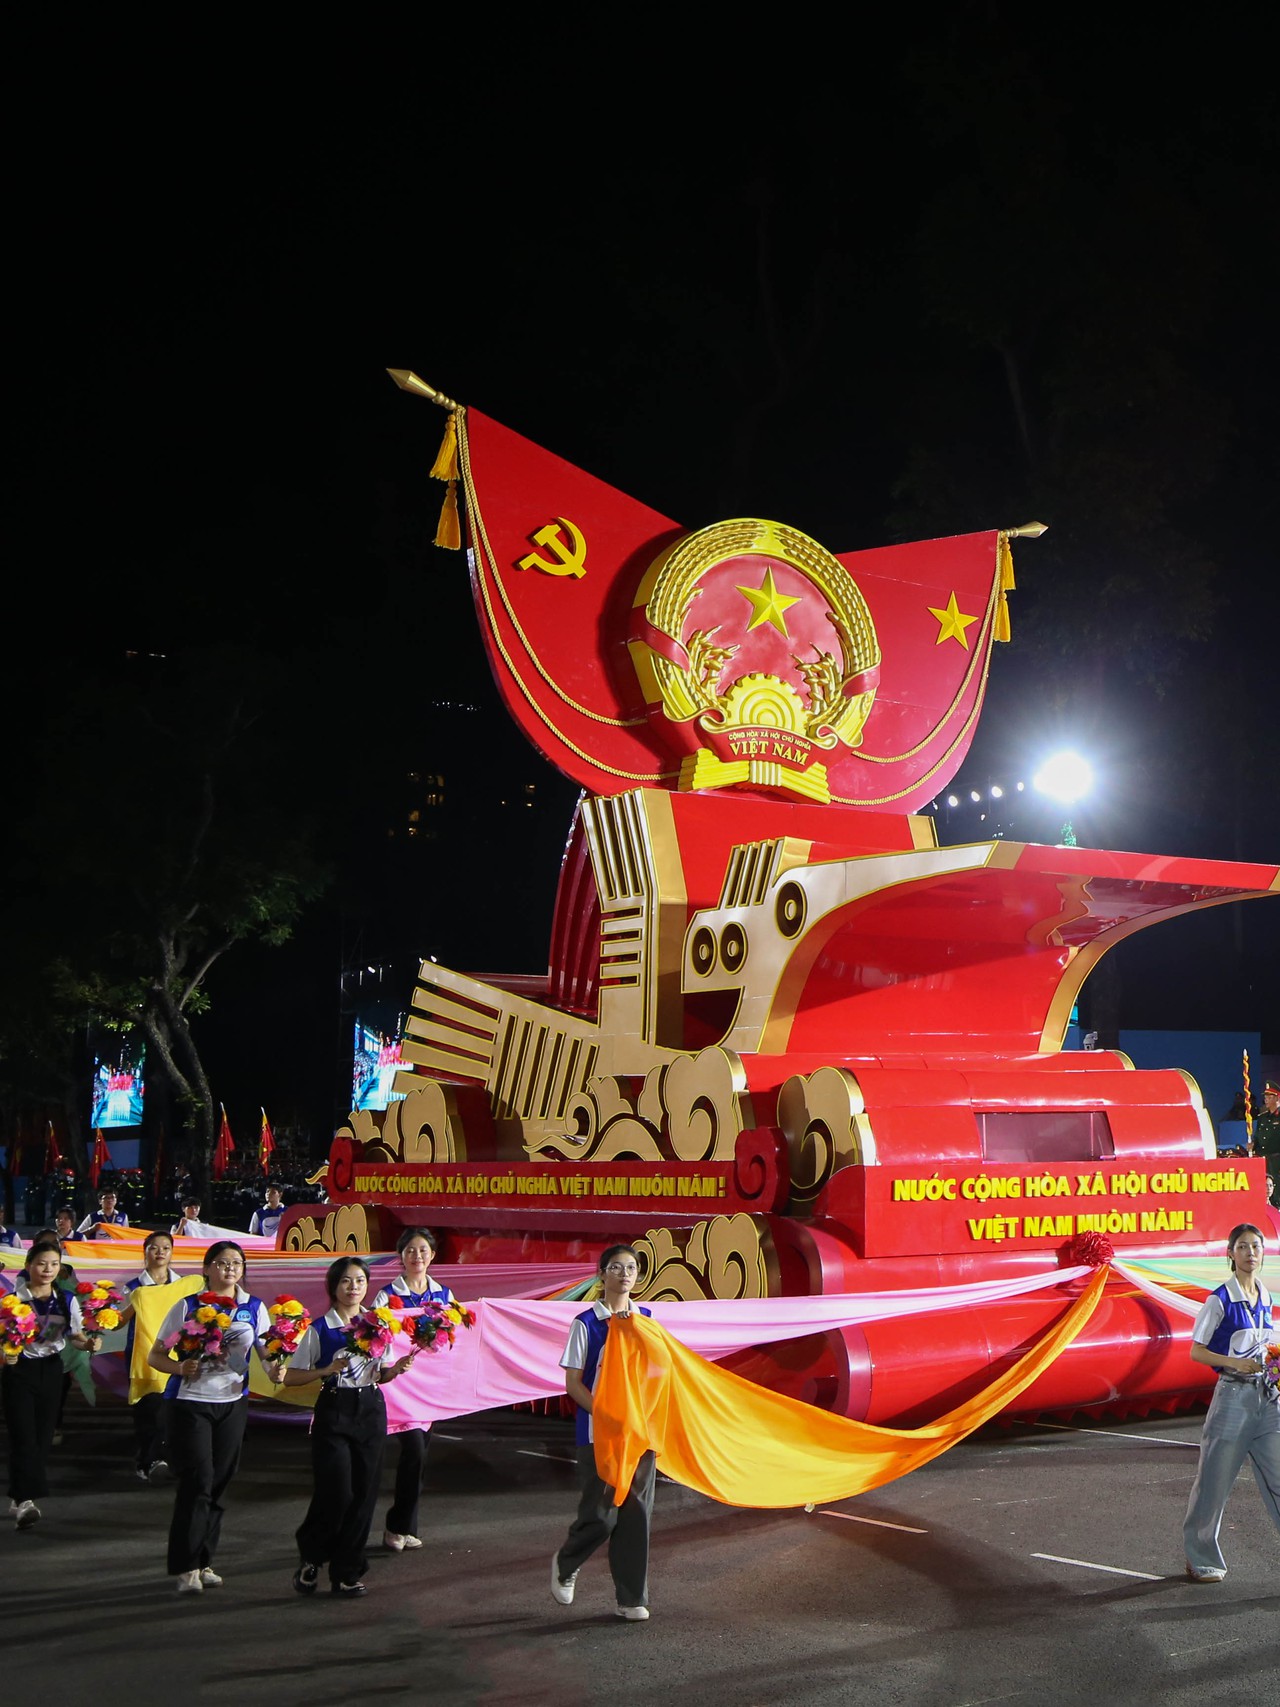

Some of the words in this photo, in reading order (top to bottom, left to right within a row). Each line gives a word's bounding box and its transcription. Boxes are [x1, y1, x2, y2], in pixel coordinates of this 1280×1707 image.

[730, 738, 769, 758] VIỆT
[772, 742, 809, 766] NAM
[354, 1172, 385, 1193] NƯỚC
[386, 1173, 418, 1196] CỘNG
[418, 1172, 443, 1193] HÒA
[446, 1172, 465, 1193] XÃ
[466, 1172, 488, 1197] HỘI
[489, 1170, 516, 1195] CHỦ
[517, 1172, 558, 1195] NGHĨA
[559, 1173, 592, 1198] VIỆT
[593, 1176, 628, 1196] NAM
[629, 1173, 676, 1197] MUÔN
[893, 1172, 957, 1202] NƯỚC
[961, 1173, 1021, 1203] CỘNG
[1025, 1171, 1071, 1198] HÒA
[1076, 1171, 1107, 1196] XÃ
[1111, 1170, 1147, 1198] HỘI
[1150, 1167, 1188, 1194] CHỦ
[1192, 1168, 1250, 1193] NGHĨA
[967, 1213, 1019, 1243] VIỆT
[1023, 1215, 1073, 1238] NAM
[1076, 1208, 1137, 1234] MUÔN
